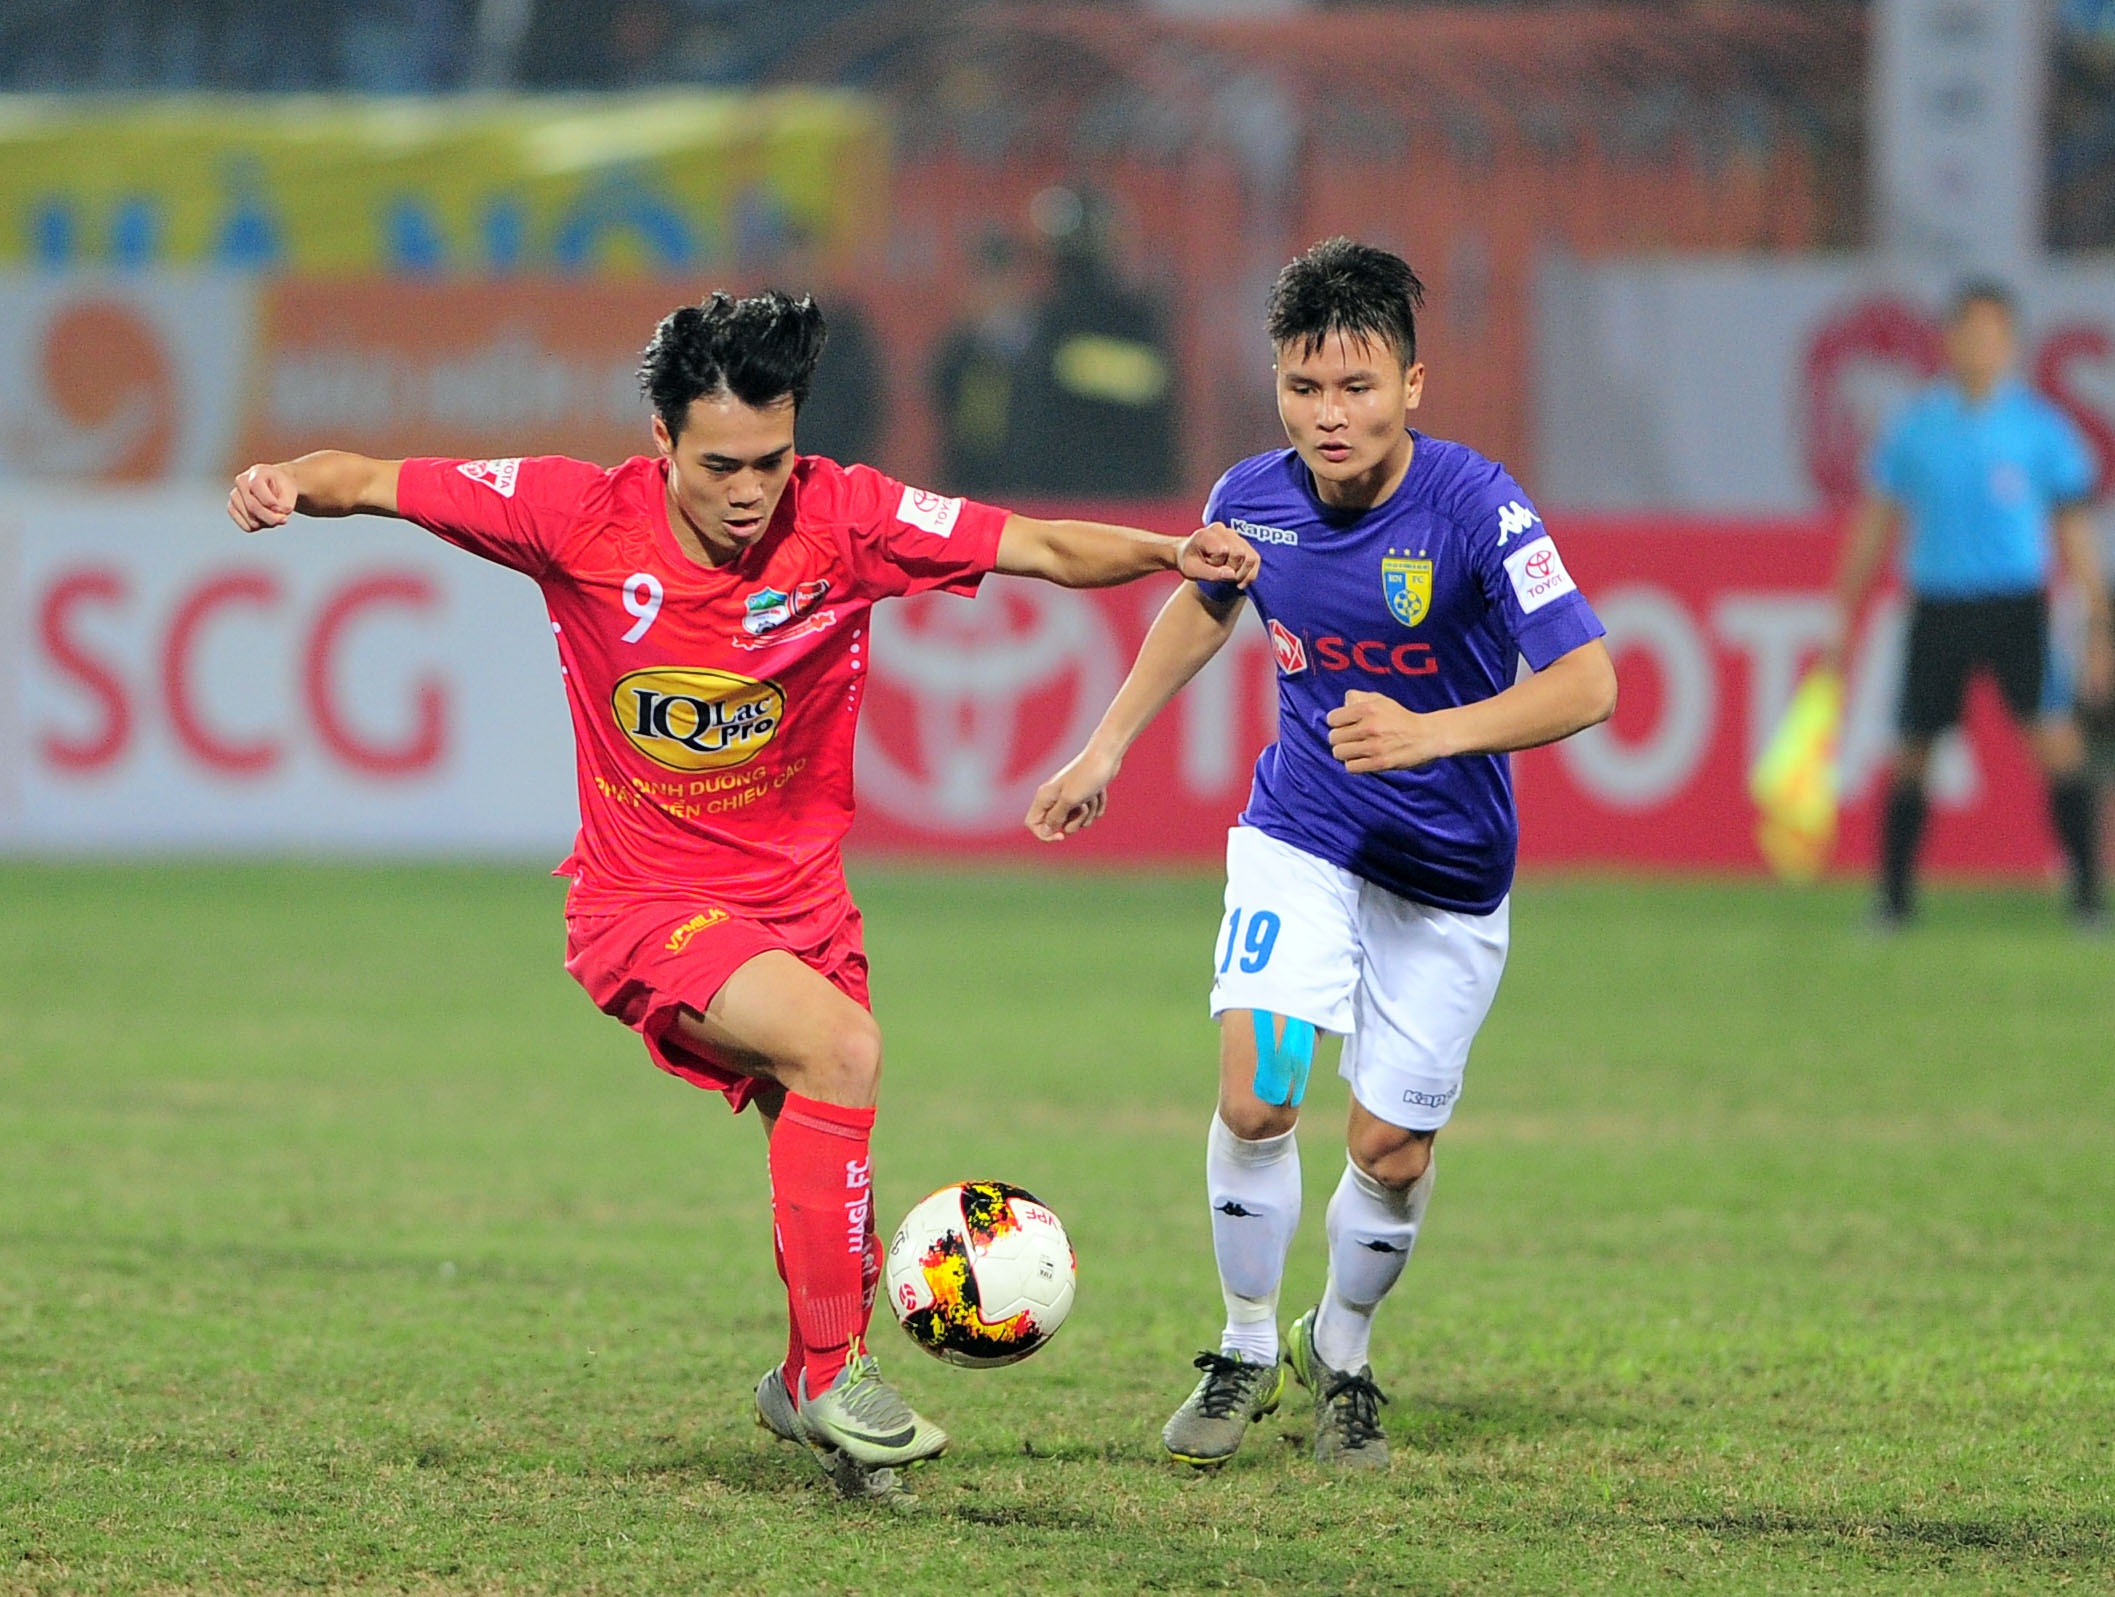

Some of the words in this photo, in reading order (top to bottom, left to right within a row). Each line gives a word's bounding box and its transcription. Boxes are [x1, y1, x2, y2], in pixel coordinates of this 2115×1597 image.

[1231, 518, 1298, 546] Kappa
[621, 573, 664, 643] 9
[33, 562, 448, 778] SCG
[1314, 636, 1440, 676] SCG
[631, 688, 726, 753] IQ
[712, 696, 773, 728] Lac
[719, 717, 776, 747] Pro
[1219, 907, 1281, 974] 19
